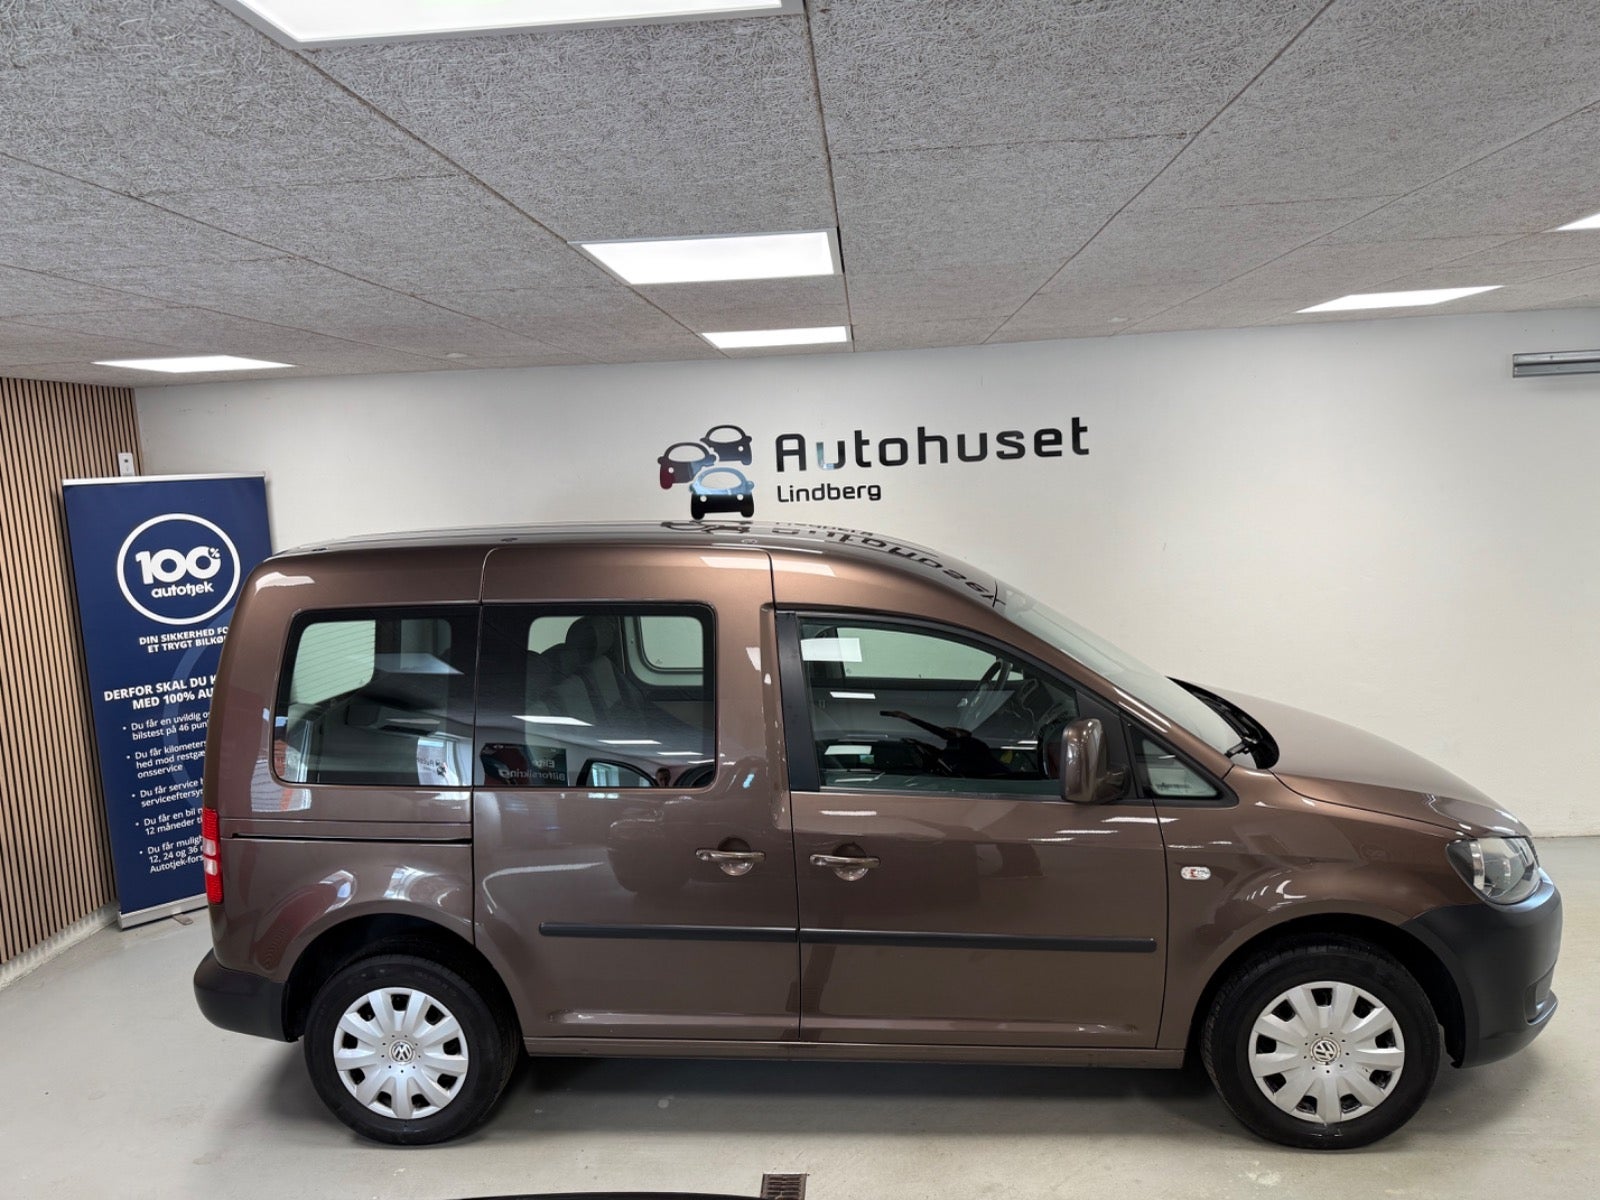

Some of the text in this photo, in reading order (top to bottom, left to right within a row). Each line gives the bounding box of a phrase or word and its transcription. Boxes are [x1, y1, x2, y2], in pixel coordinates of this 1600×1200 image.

[775, 417, 1090, 472] Autohuset
[777, 484, 882, 503] Lindberg
[151, 581, 214, 598] autotjek
[139, 626, 229, 645] DIN SIKKERHED FO
[148, 645, 160, 653] ET
[162, 640, 193, 651] TRYGT
[104, 685, 153, 701] DERFOR
[156, 680, 187, 693] SKAL
[189, 676, 207, 688] DU
[132, 688, 214, 710] MED 100% AU
[131, 722, 144, 731] Du
[146, 719, 158, 728] får
[160, 718, 172, 726] en
[173, 712, 201, 723] uvildig
[132, 728, 164, 740] bilstest
[166, 725, 177, 736] på
[178, 723, 190, 732] 46
[135, 751, 148, 760] Du
[149, 748, 162, 757] får
[136, 760, 153, 769] hed
[155, 755, 175, 765] mod
[137, 763, 183, 779] onsservice
[140, 789, 153, 798] Du
[154, 785, 166, 794] får
[168, 779, 199, 792] service
[144, 818, 157, 827] Du
[158, 813, 170, 823] får
[172, 811, 184, 820] en
[185, 808, 196, 817] bil
[145, 826, 155, 836] 12
[157, 818, 195, 833] måneder
[147, 846, 160, 855] Du
[162, 841, 174, 851] får
[163, 850, 174, 859] 24
[175, 849, 186, 859] og
[187, 845, 198, 855] 36
